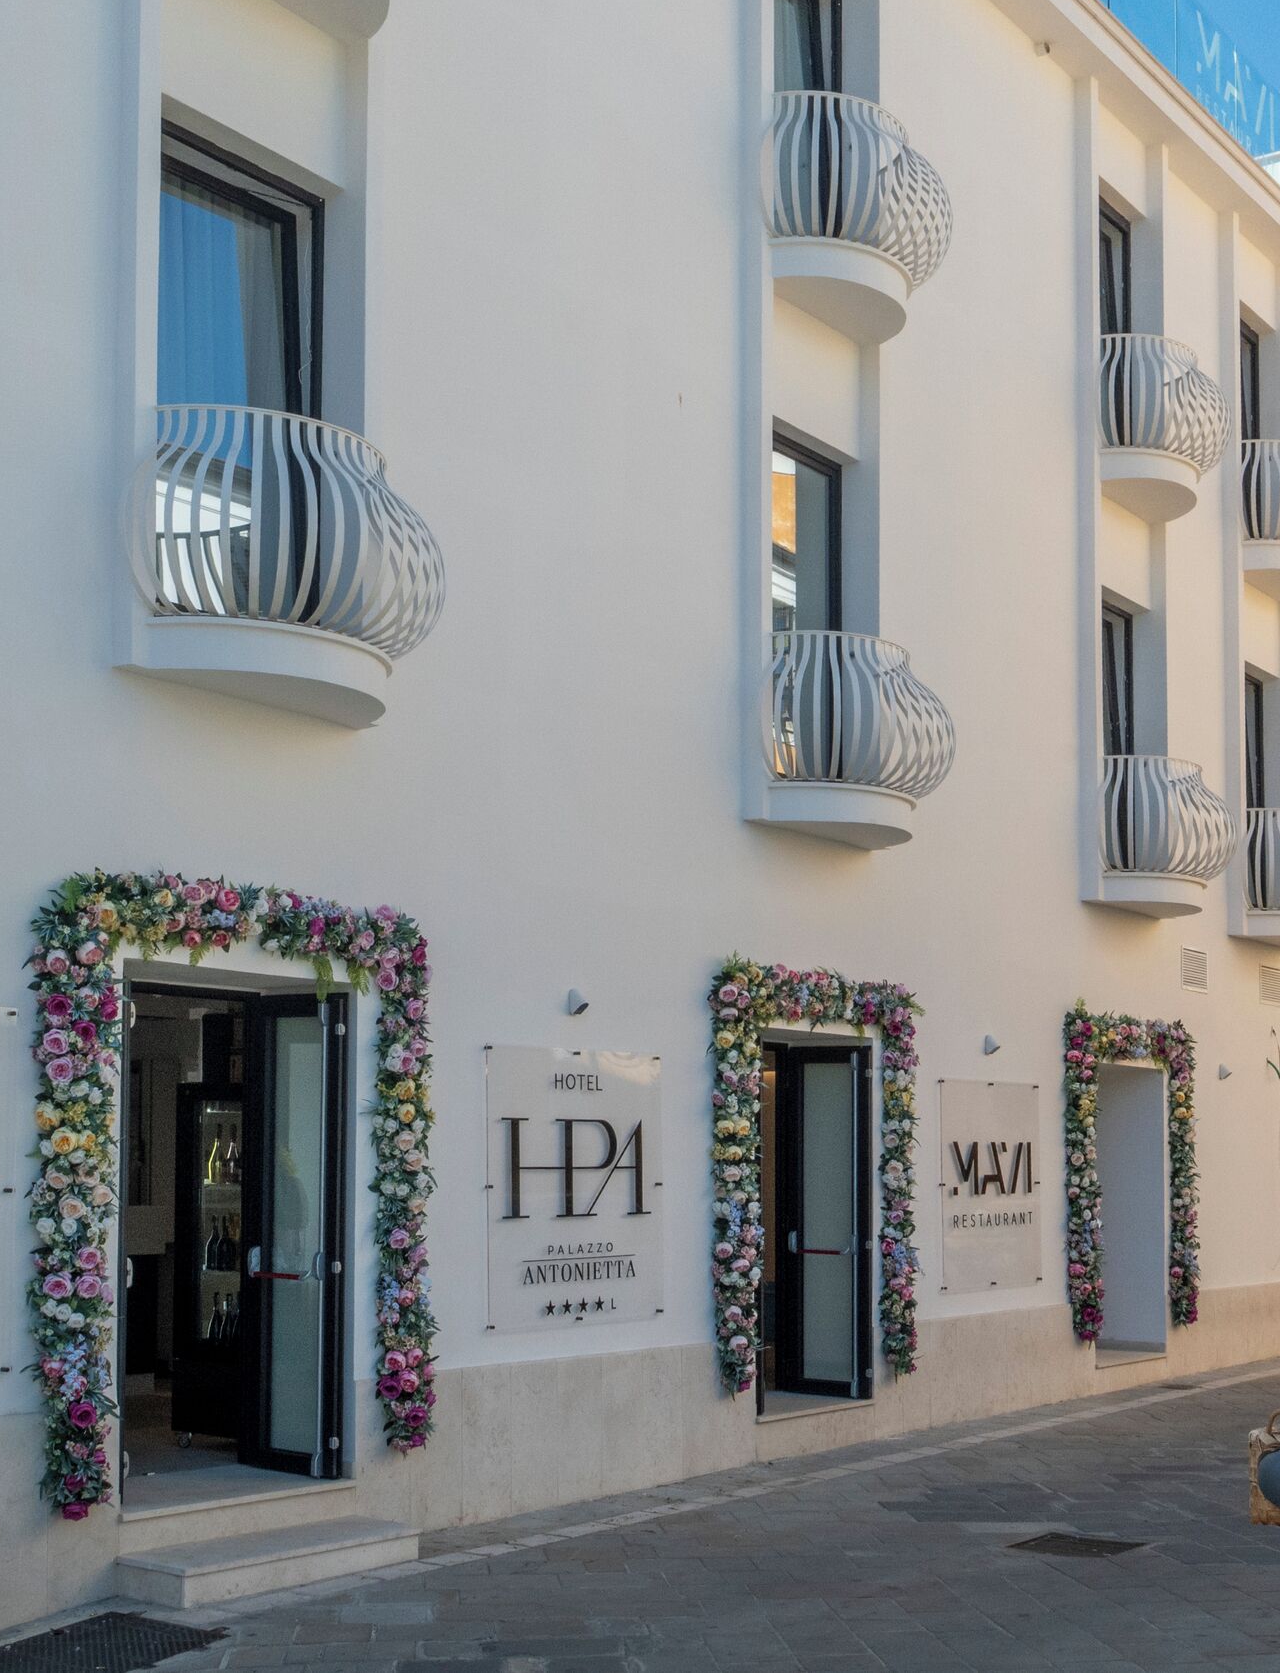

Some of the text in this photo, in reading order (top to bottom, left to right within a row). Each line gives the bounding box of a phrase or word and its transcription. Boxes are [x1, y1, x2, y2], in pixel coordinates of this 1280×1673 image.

[554, 1073, 603, 1091] HOTEL
[501, 1117, 651, 1219] HPA
[953, 1211, 1033, 1228] RESTAURANT
[548, 1242, 614, 1255] PALAZZO
[523, 1260, 636, 1285] ANTONIETTA
